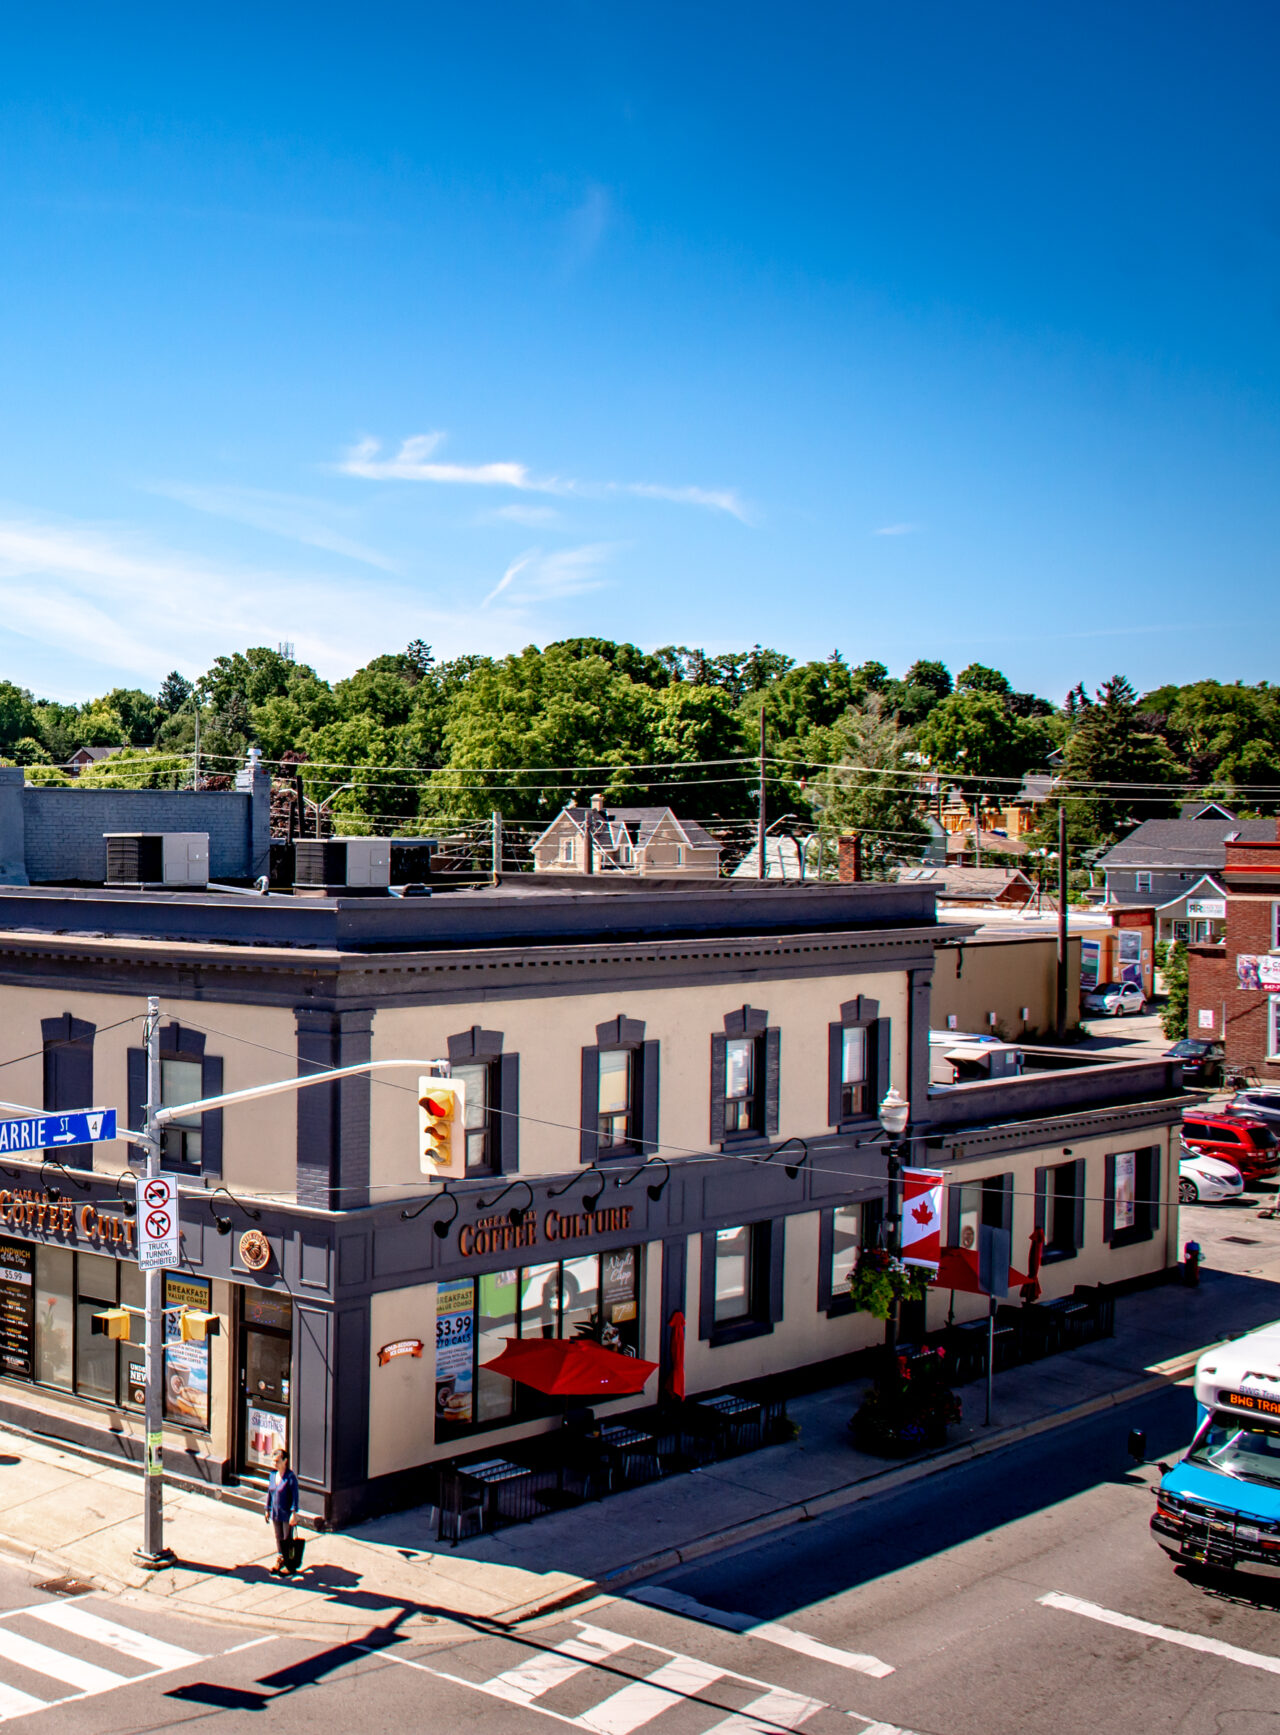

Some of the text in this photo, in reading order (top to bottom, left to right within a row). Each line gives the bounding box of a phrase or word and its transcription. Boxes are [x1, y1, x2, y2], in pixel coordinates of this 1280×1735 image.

[60, 1117, 70, 1131] ST
[91, 1121, 98, 1132] 4
[42, 1193, 73, 1208] ERY
[81, 1205, 136, 1243] CULT
[459, 1206, 634, 1257] COFFEE CULTURE
[148, 1241, 169, 1250] TRUCK
[146, 1249, 172, 1259] TURNING
[15, 1255, 26, 1267] Day
[141, 1257, 177, 1267] PROHIBITED
[4, 1269, 23, 1280] $5.99
[168, 1284, 208, 1298] BREAKFAST
[168, 1292, 208, 1306] VALUE COMBO
[453, 1299, 472, 1308] COMBO
[436, 1316, 471, 1337] $3.99
[452, 1334, 471, 1345] CALS
[130, 1363, 146, 1373] UNDE
[1239, 1385, 1260, 1397] BWG
[1231, 1393, 1253, 1407] BWG
